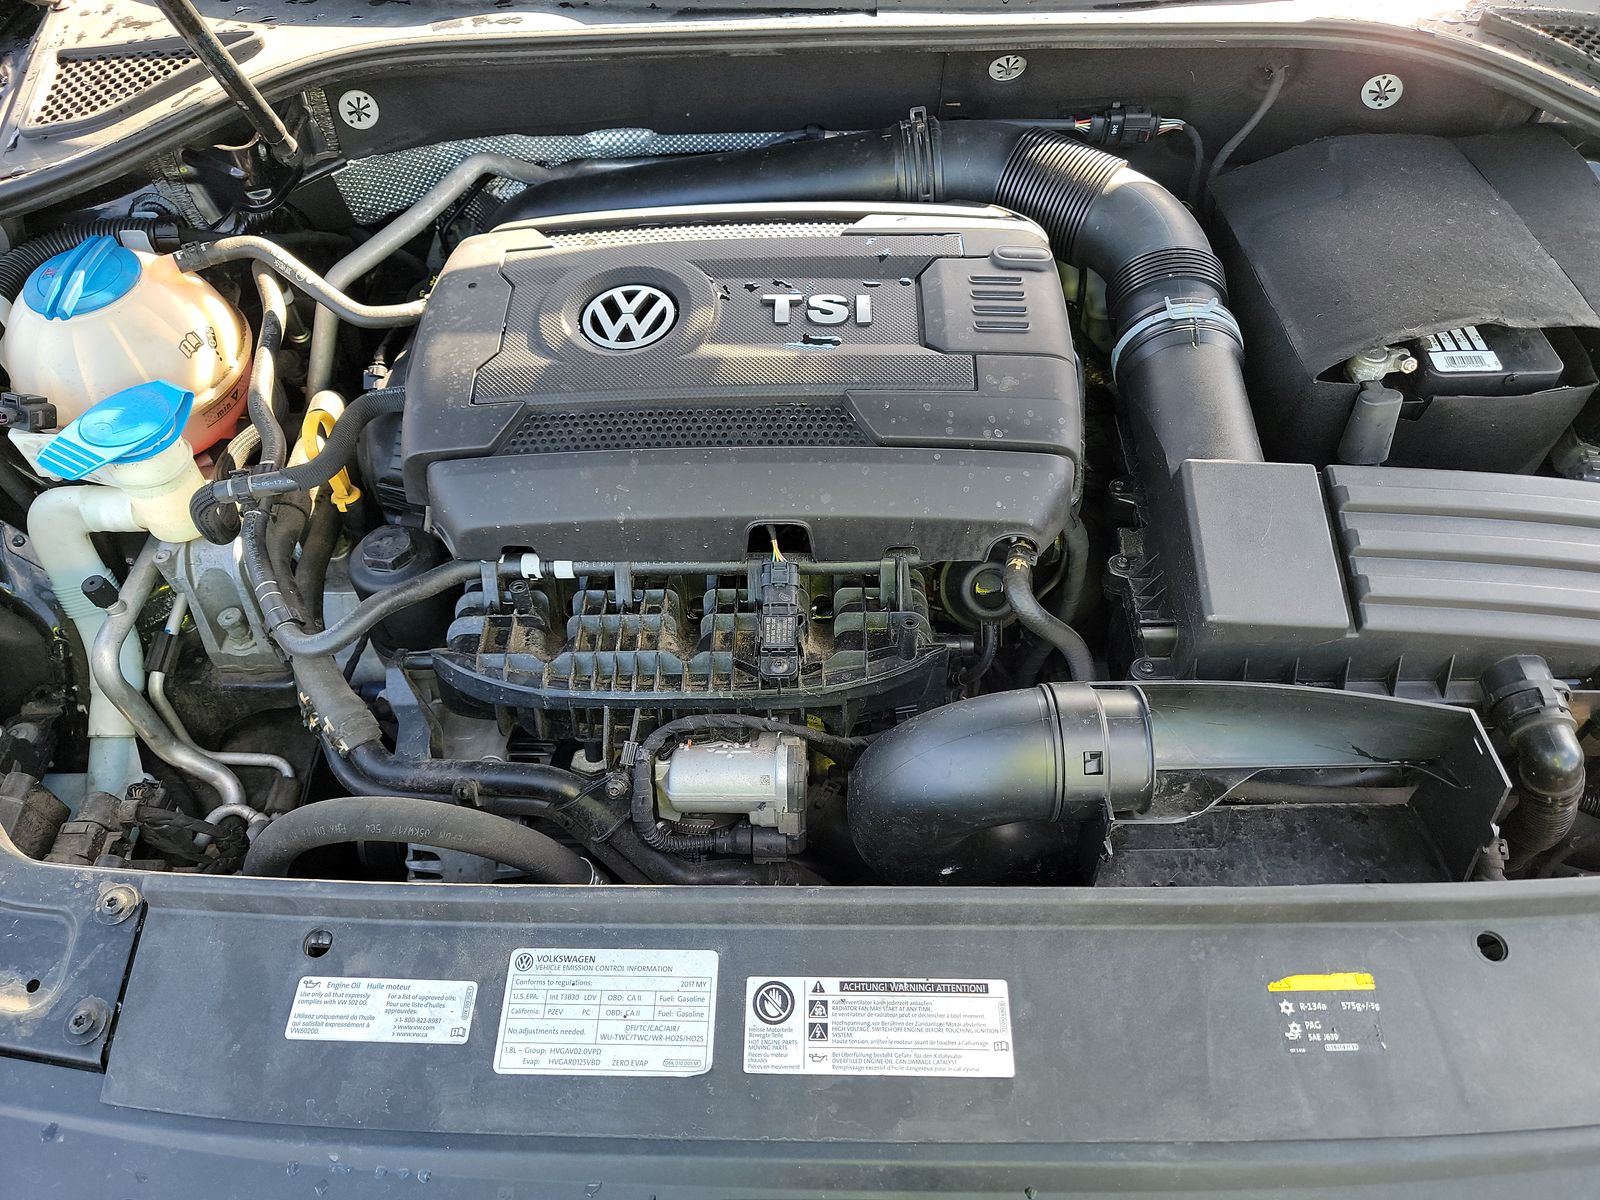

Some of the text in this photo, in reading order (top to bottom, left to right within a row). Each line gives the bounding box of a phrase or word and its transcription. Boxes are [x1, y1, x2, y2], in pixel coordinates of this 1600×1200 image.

[760, 293, 873, 326] TSI
[216, 402, 232, 418] min
[536, 954, 596, 963] VOLKSWAGEN
[562, 964, 594, 972] EMISSION
[626, 965, 673, 973] INFORMATION
[327, 981, 350, 990] Engine
[515, 978, 546, 986] Conforms
[555, 979, 593, 987] regulations:
[843, 983, 986, 993] ACHTUNG! WARNING! ATTENTION!
[315, 1013, 349, 1021] uniquement
[676, 1010, 705, 1018] Gasoline
[625, 1024, 680, 1032] DFI/TC/CAC/AIR/
[1304, 1020, 1322, 1030] PAG
[519, 1027, 558, 1036] adjustments
[560, 1028, 586, 1036] needed.
[1307, 1033, 1321, 1042] SAE
[524, 1047, 547, 1055] Group:
[522, 1057, 540, 1066] Evap:
